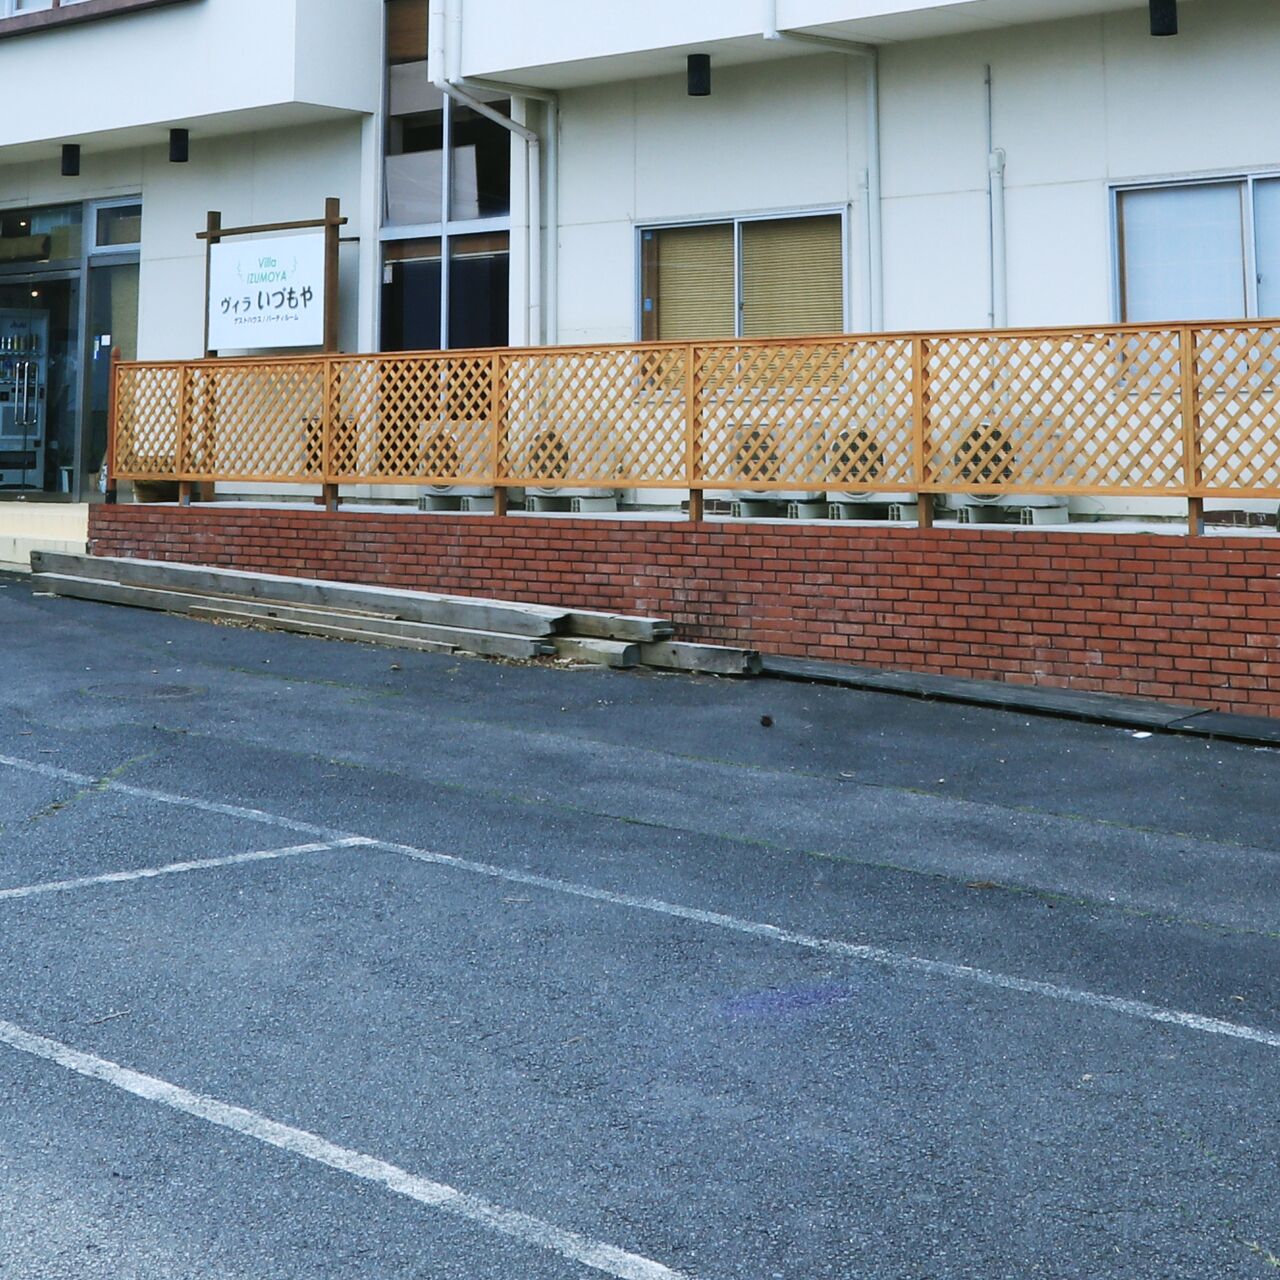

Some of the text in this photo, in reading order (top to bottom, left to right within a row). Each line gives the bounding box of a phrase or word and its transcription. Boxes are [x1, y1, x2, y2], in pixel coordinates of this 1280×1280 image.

[258, 256, 277, 268] Villa
[246, 270, 287, 284] IZUMOYA
[221, 285, 313, 314] ヴィラ いづもや
